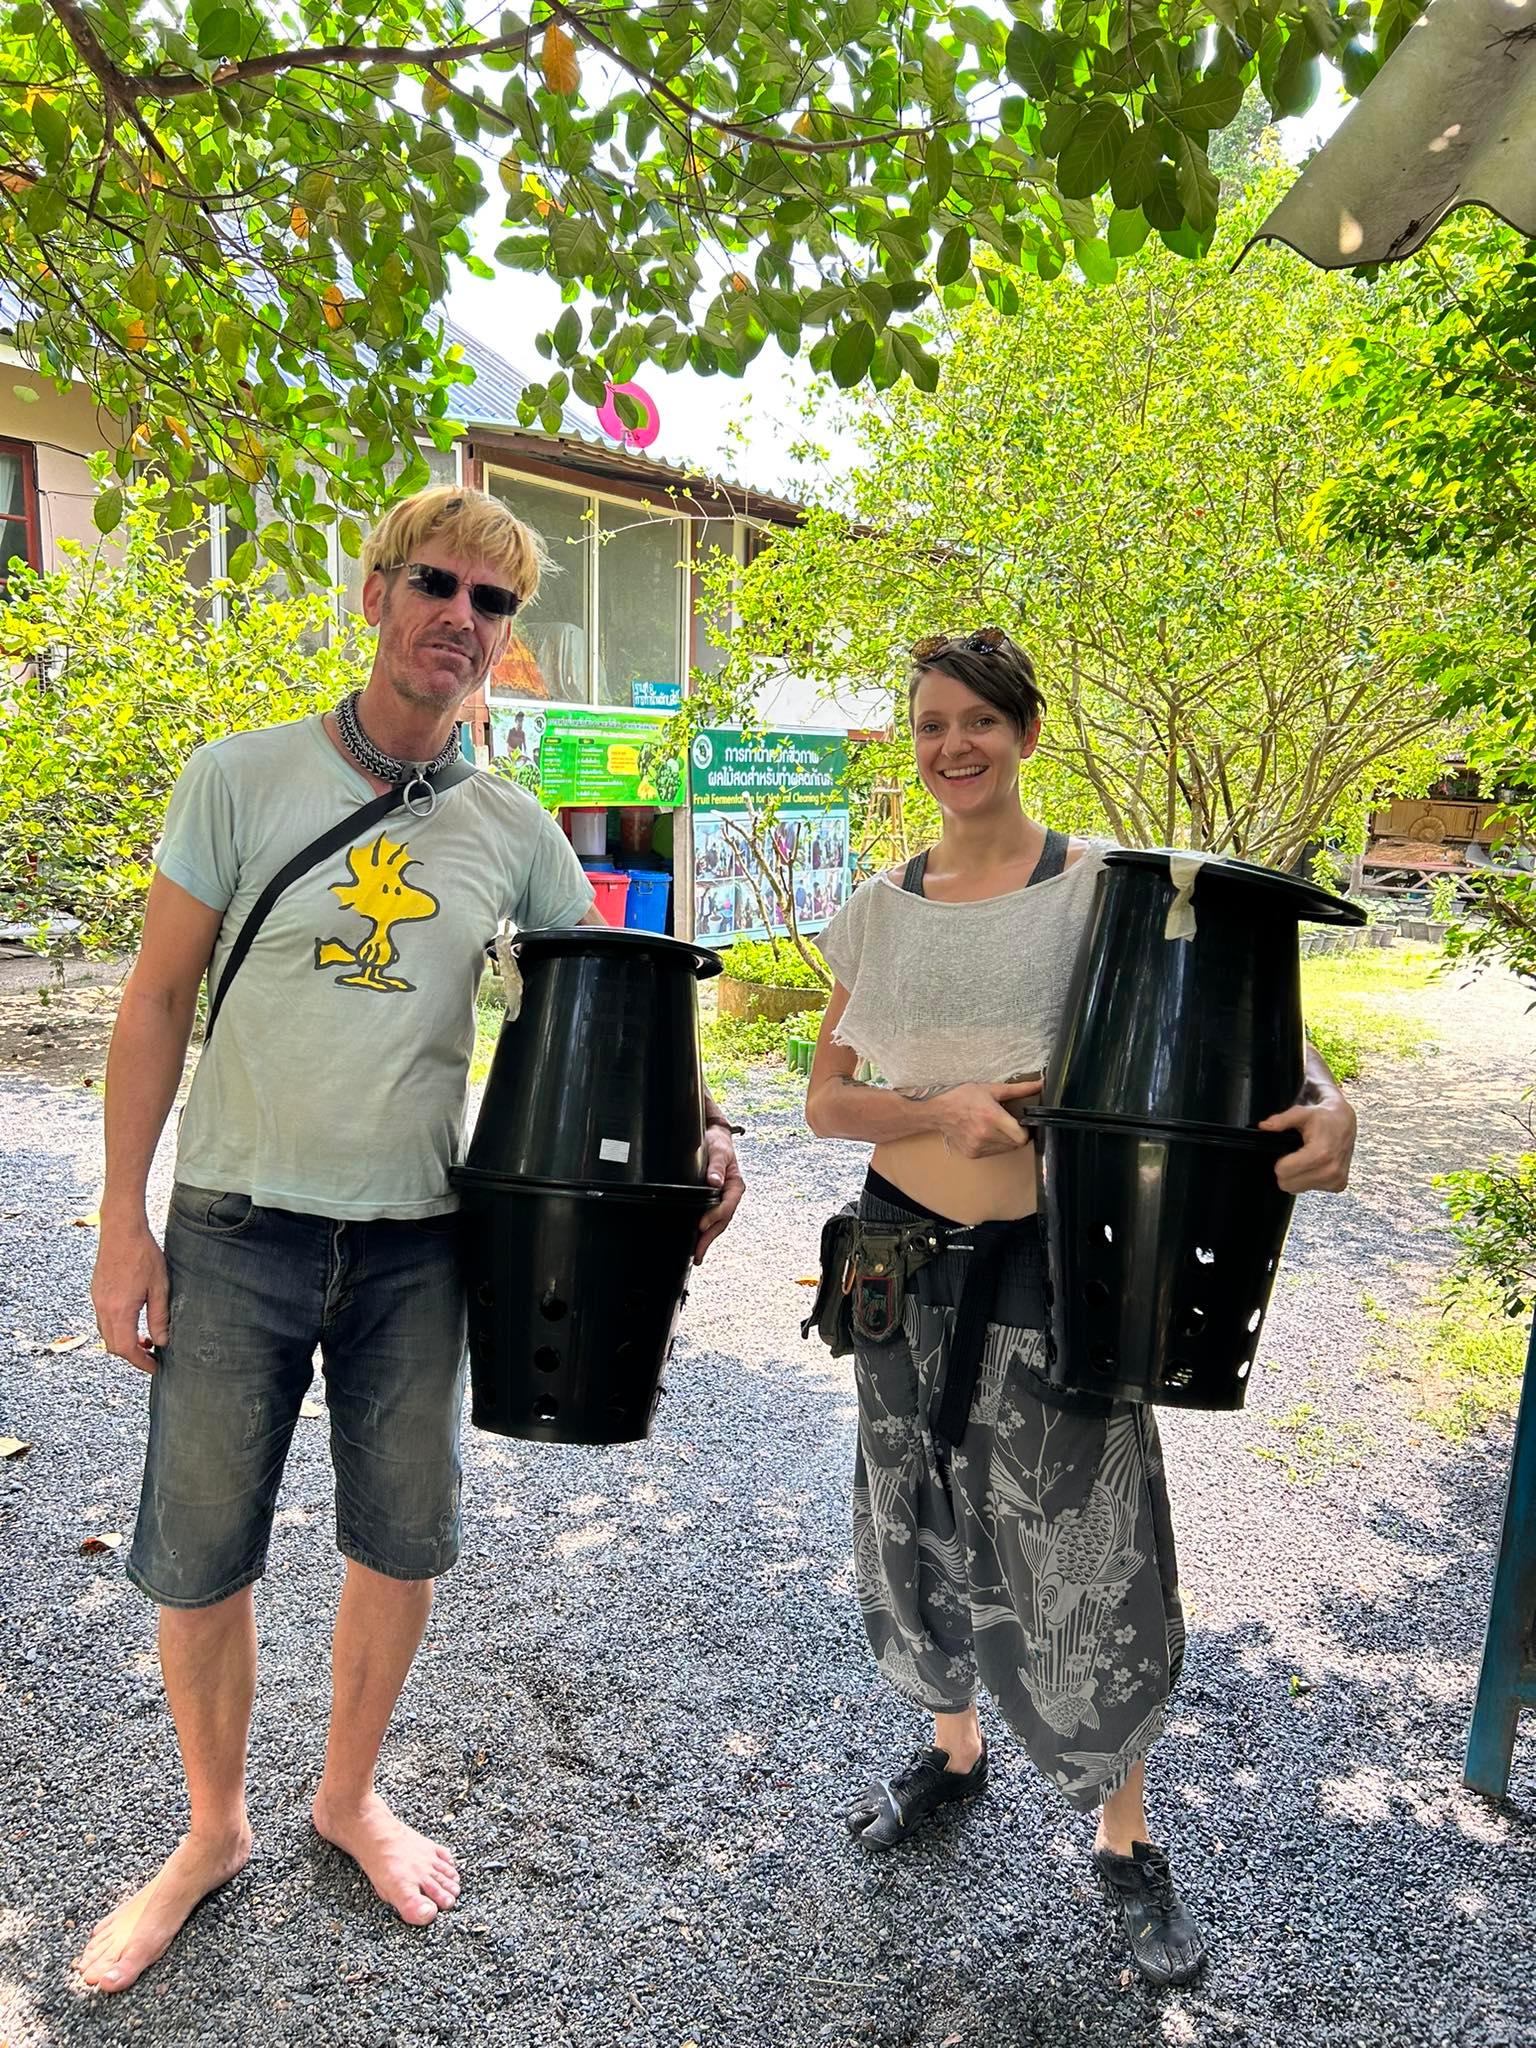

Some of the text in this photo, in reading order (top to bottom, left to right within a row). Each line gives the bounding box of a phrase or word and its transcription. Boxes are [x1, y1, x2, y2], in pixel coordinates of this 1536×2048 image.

[707, 765, 834, 787] ผลไม้สดสำหรับทำผลตภัณฑ์
[693, 793, 710, 805] Fruit
[711, 793, 754, 805] Fermentatn
[793, 792, 819, 805] Cleaning
